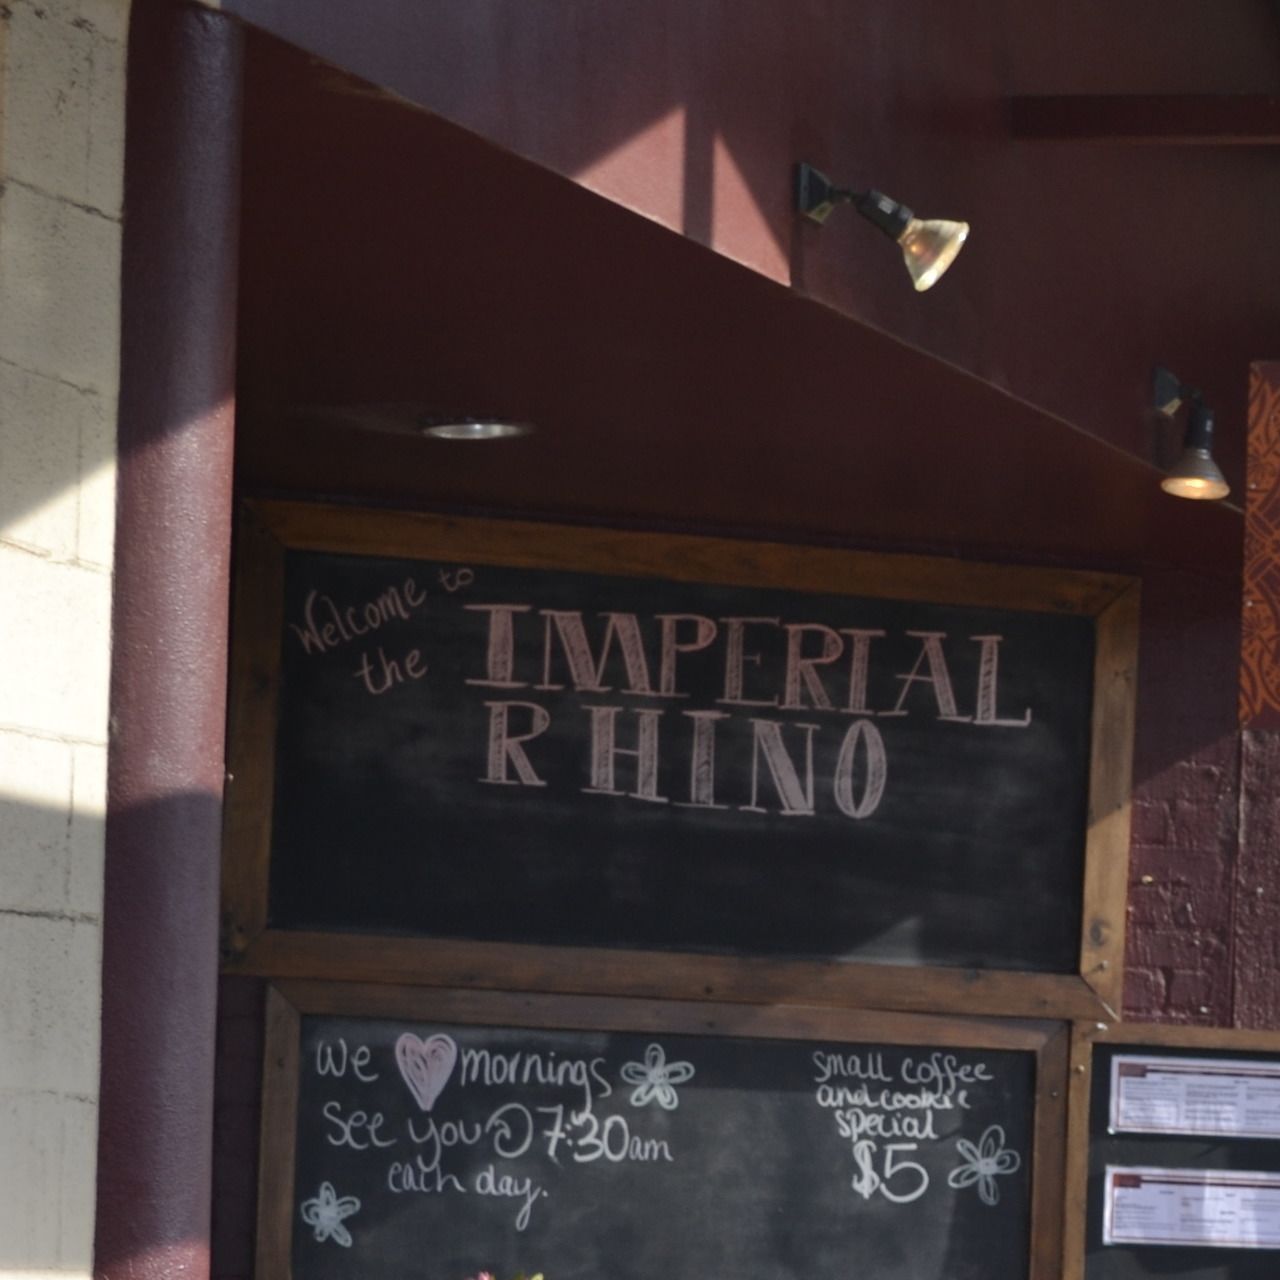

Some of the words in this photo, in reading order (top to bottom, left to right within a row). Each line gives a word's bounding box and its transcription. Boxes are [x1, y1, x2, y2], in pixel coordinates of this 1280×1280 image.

[289, 573, 428, 656] Welcome
[439, 566, 475, 597] to
[355, 647, 428, 696] the
[464, 603, 1033, 728] IMPERIAL
[477, 700, 888, 819] RHINO
[460, 1045, 613, 1115] mornings
[816, 1084, 879, 1108] and
[901, 1052, 994, 1098] coffee
[323, 1101, 397, 1150] See
[407, 1117, 482, 1173] you
[834, 1107, 939, 1143] special
[387, 1160, 467, 1193] each
[851, 1139, 930, 1204] $5
